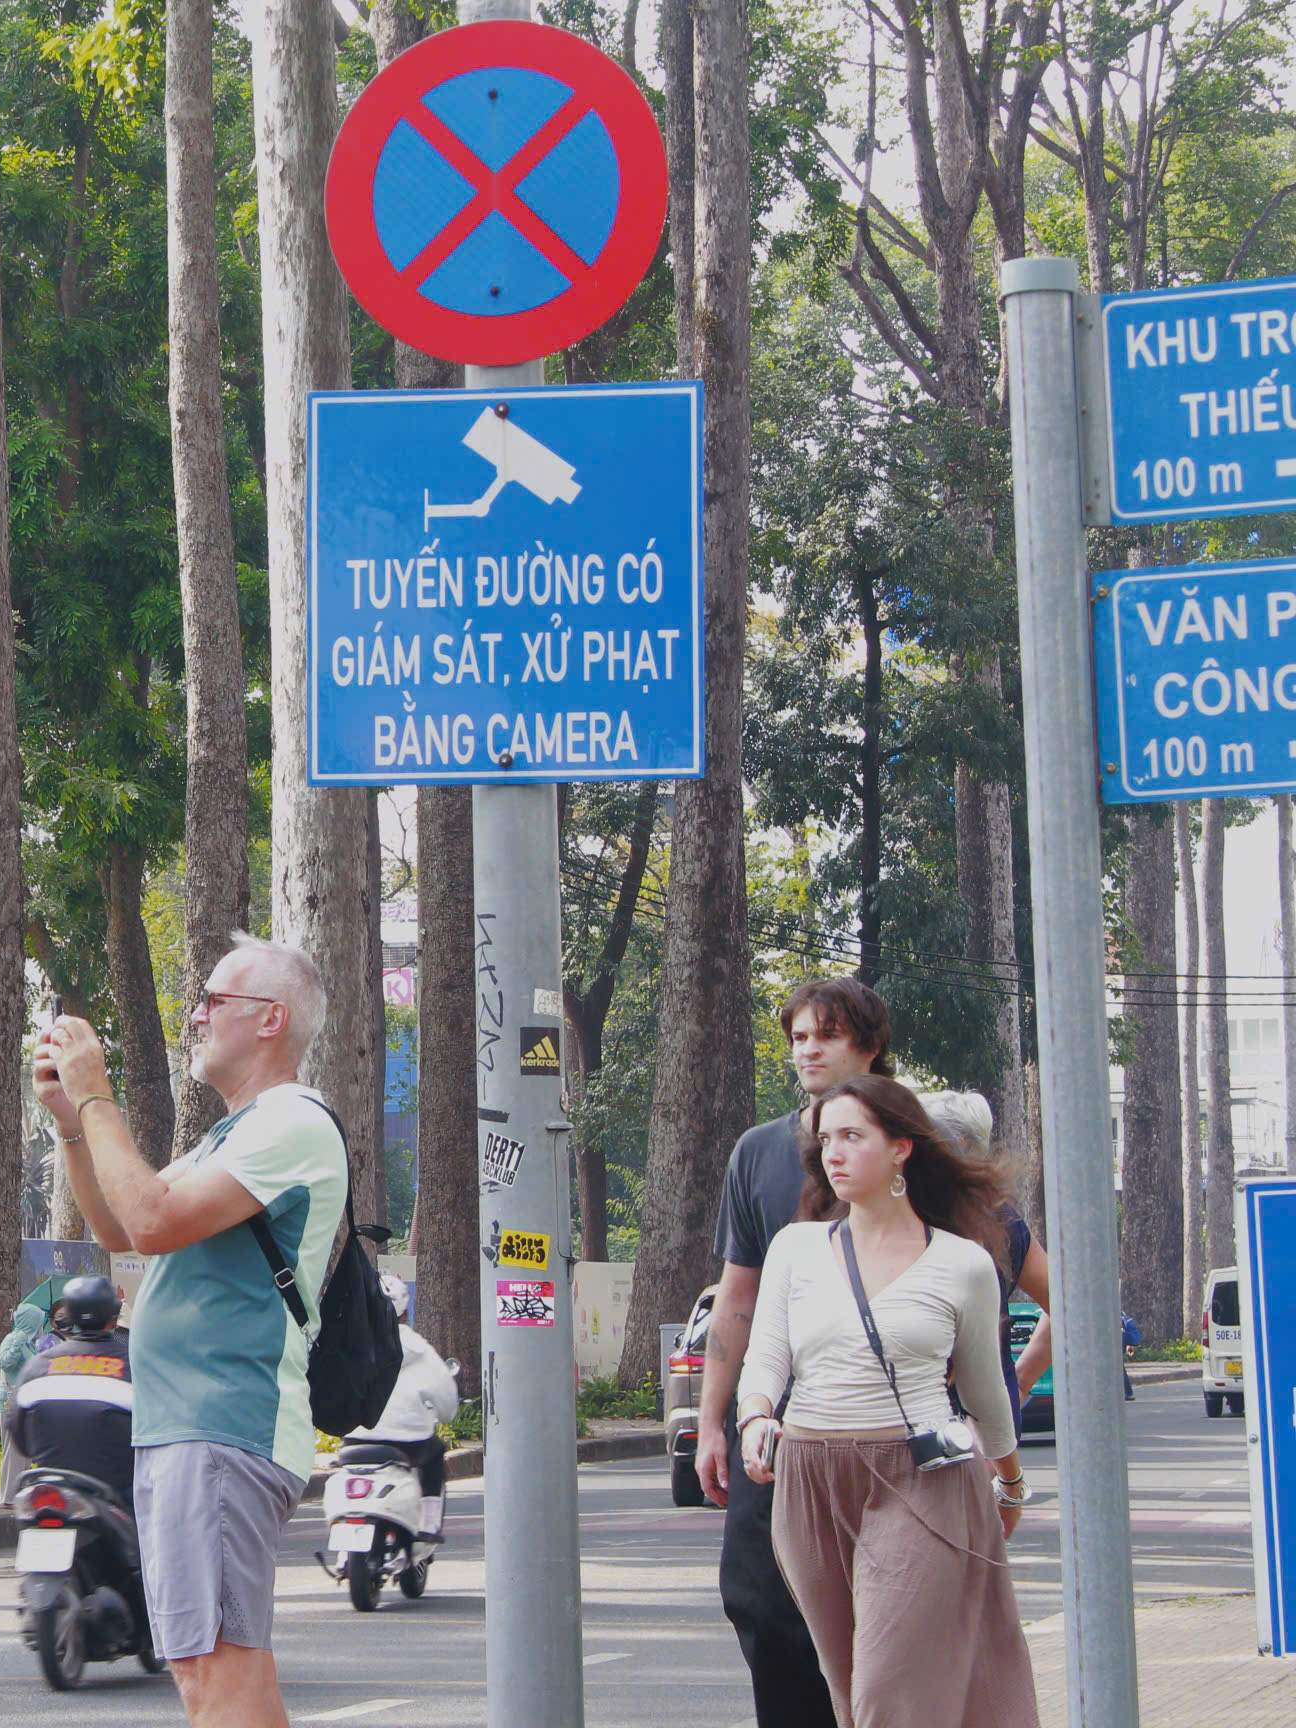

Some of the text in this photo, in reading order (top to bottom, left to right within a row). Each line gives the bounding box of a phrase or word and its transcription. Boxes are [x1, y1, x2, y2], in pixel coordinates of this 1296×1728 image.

[1127, 310, 1296, 369] KHU TR
[1133, 457, 1242, 500] 100 m
[346, 538, 663, 609] TUYẾN ĐƯỜNG CÓ
[1136, 586, 1248, 646] VĂN
[332, 613, 680, 693] GIÁM SÁT, XỬ PHẠT
[1154, 658, 1296, 718] CÔNG
[374, 690, 638, 766] BẰNG CAMERA
[1143, 735, 1254, 778] 100 m
[520, 1056, 560, 1068] kerkrade
